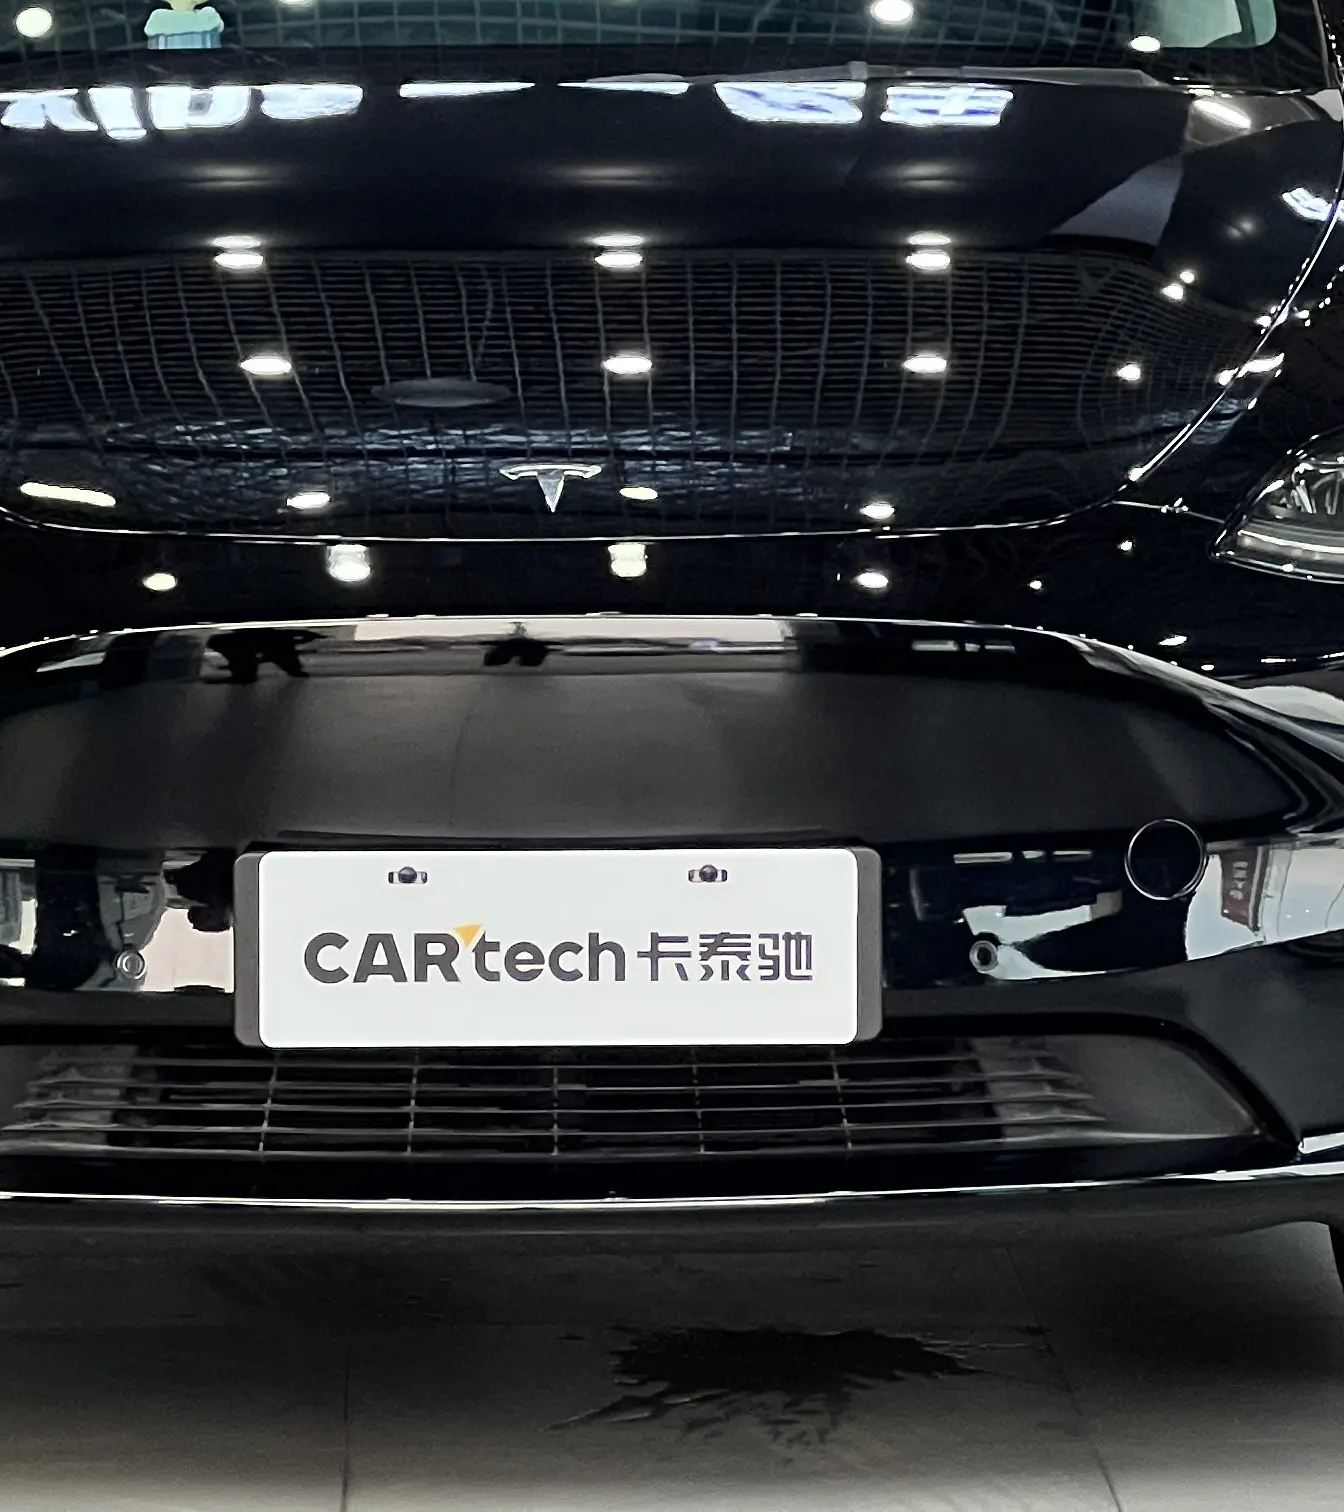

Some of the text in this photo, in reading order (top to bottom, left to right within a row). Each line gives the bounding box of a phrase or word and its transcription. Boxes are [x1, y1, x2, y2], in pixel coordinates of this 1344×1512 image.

[303, 928, 813, 984] CARtech 卡泰驰
